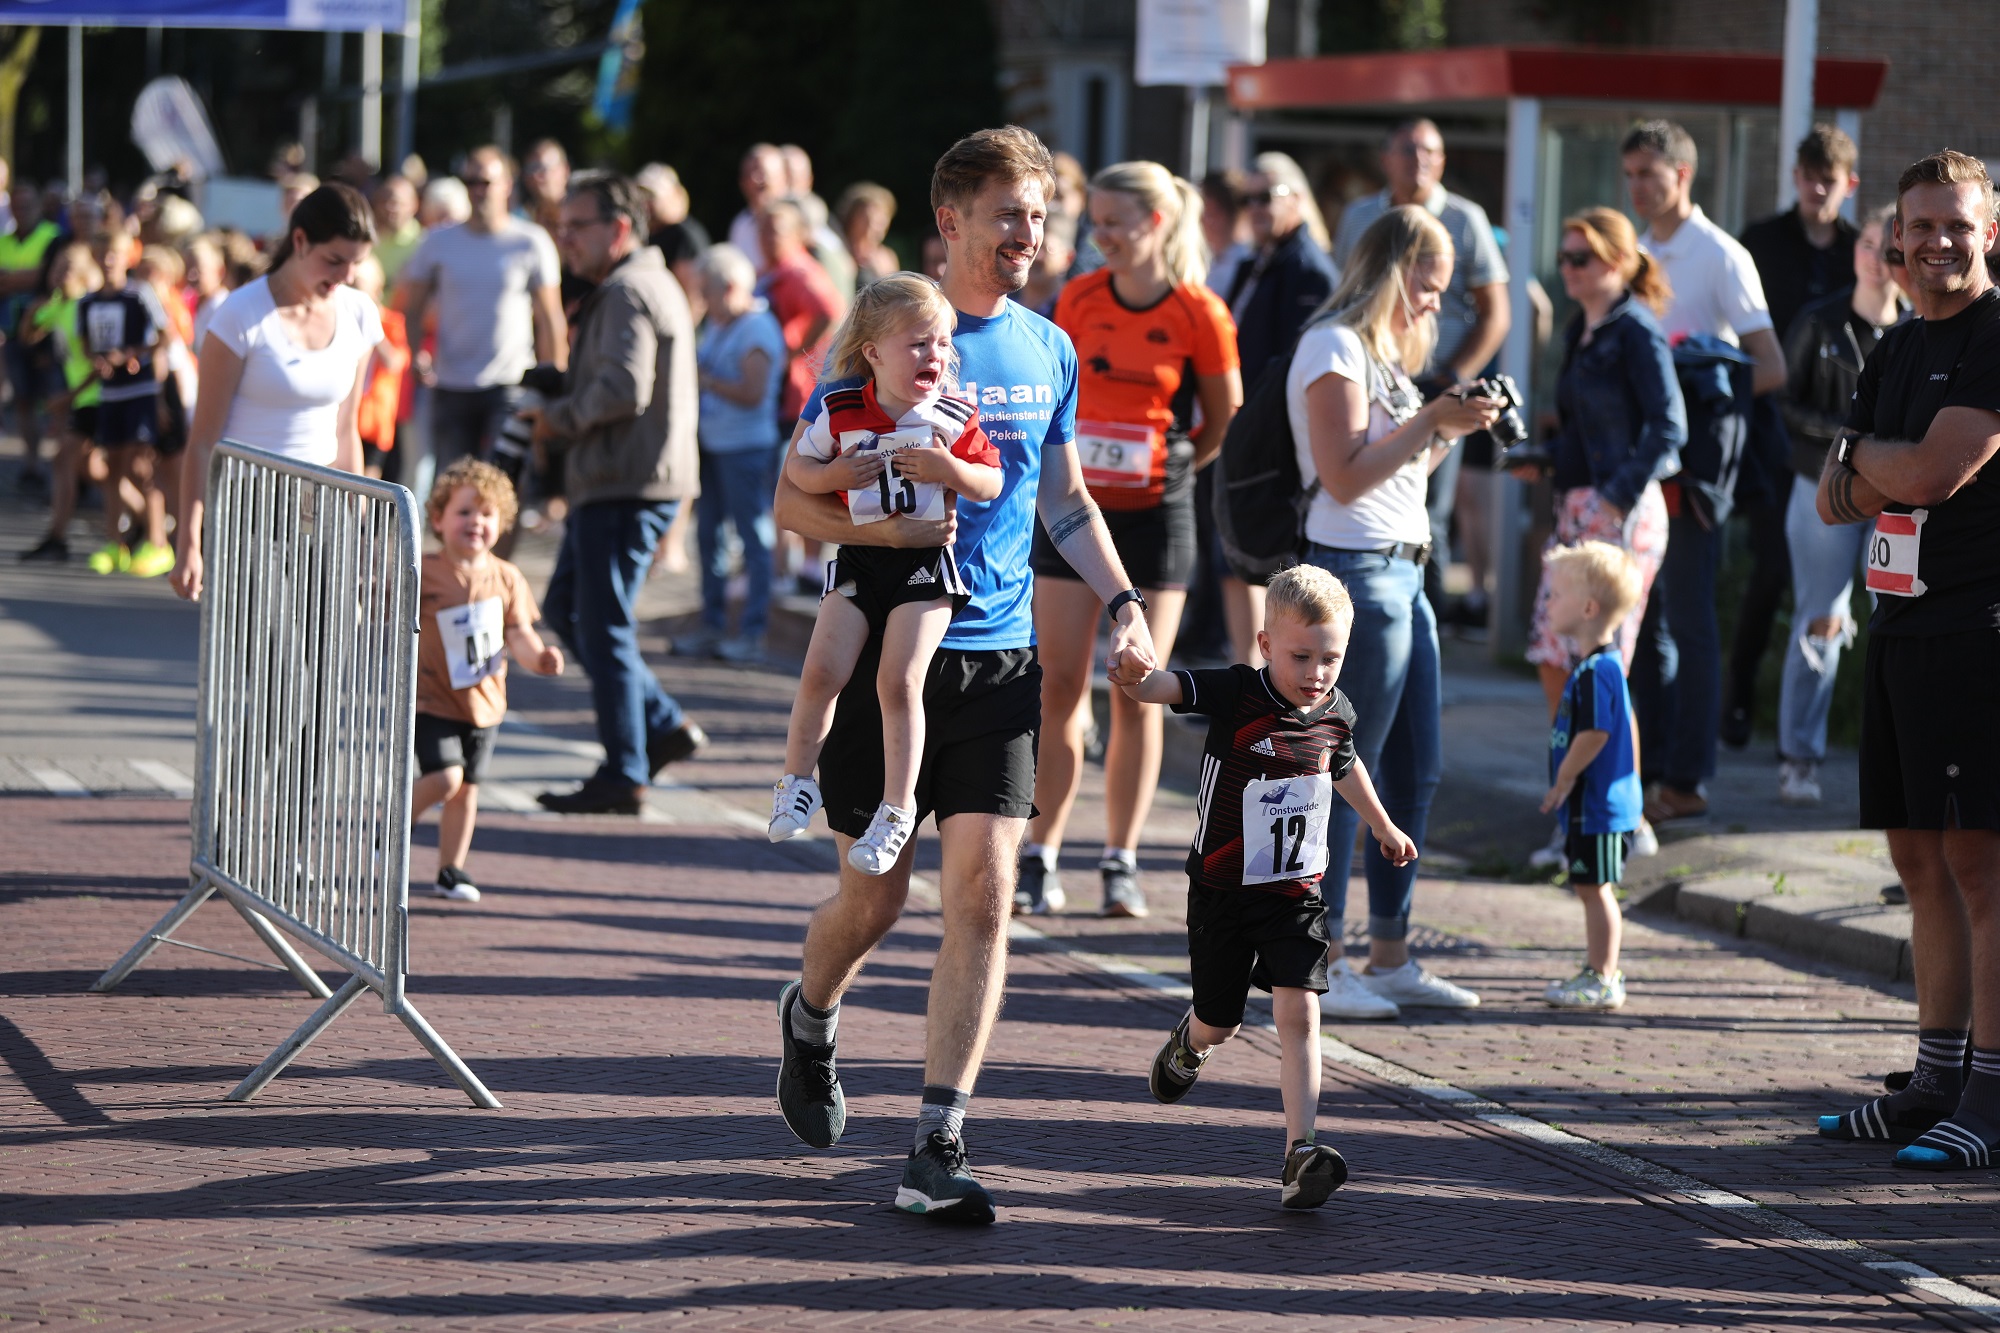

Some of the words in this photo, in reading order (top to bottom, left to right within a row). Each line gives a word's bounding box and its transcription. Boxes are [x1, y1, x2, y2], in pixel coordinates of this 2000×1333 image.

[979, 410, 1038, 423] elsdiensten
[989, 429, 1027, 441] Pekela
[1087, 441, 1123, 467] 79
[907, 577, 936, 586] adidas
[1250, 745, 1276, 757] adidas
[1269, 802, 1319, 816] Onstwedde
[1270, 815, 1306, 874] 12
